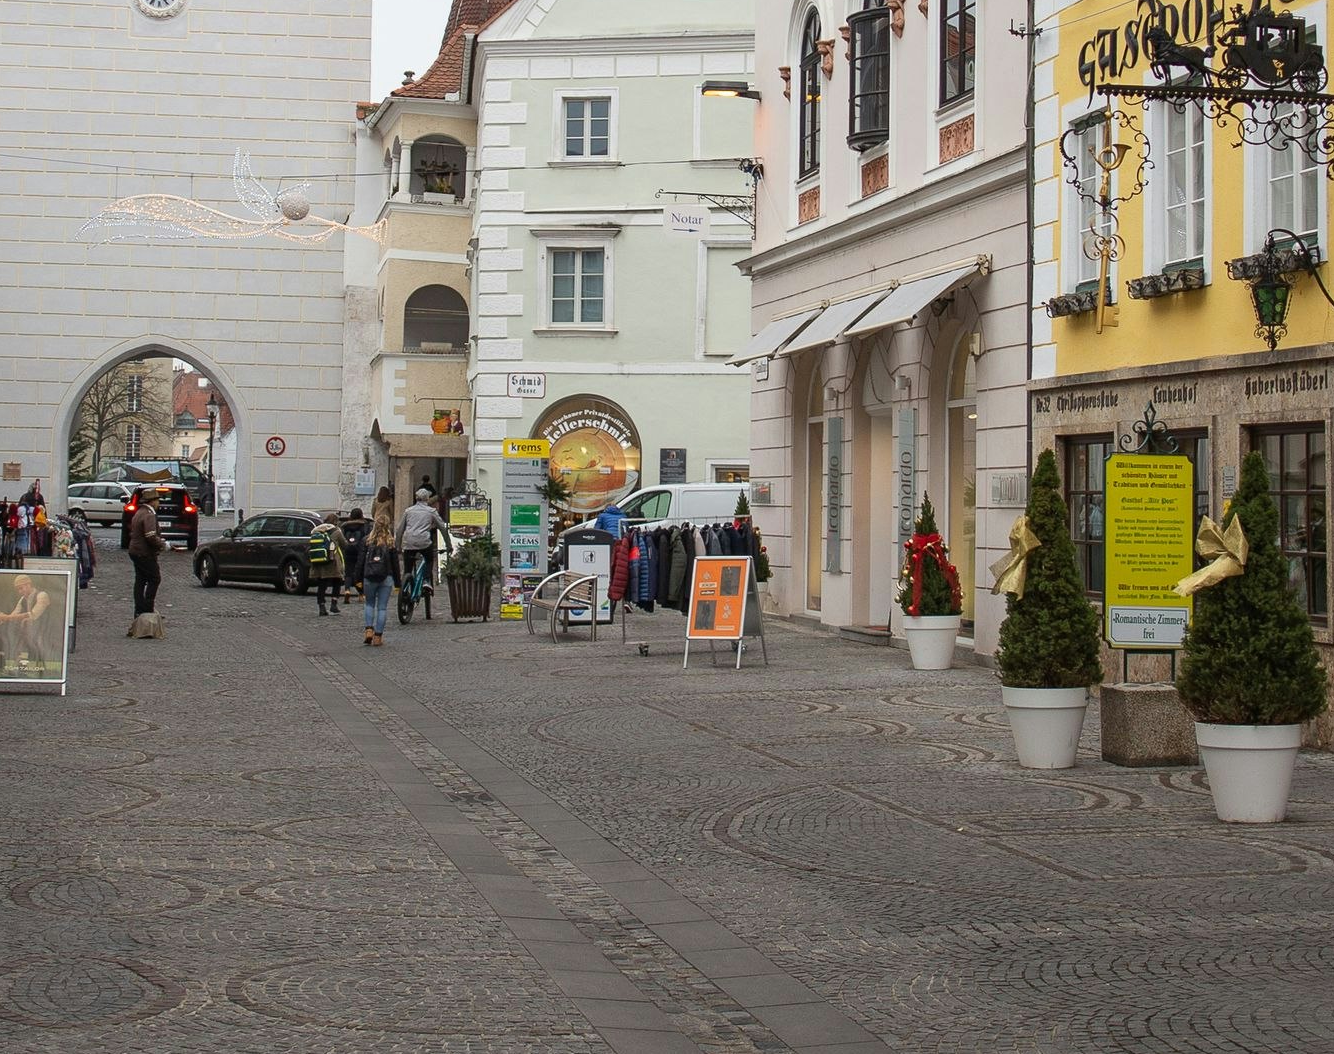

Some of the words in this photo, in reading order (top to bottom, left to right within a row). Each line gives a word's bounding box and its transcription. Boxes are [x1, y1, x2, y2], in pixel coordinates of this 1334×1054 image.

[671, 212, 703, 225] Notar
[511, 442, 542, 451] krems
[510, 537, 539, 545] KREMS
[1143, 628, 1155, 639] frei
